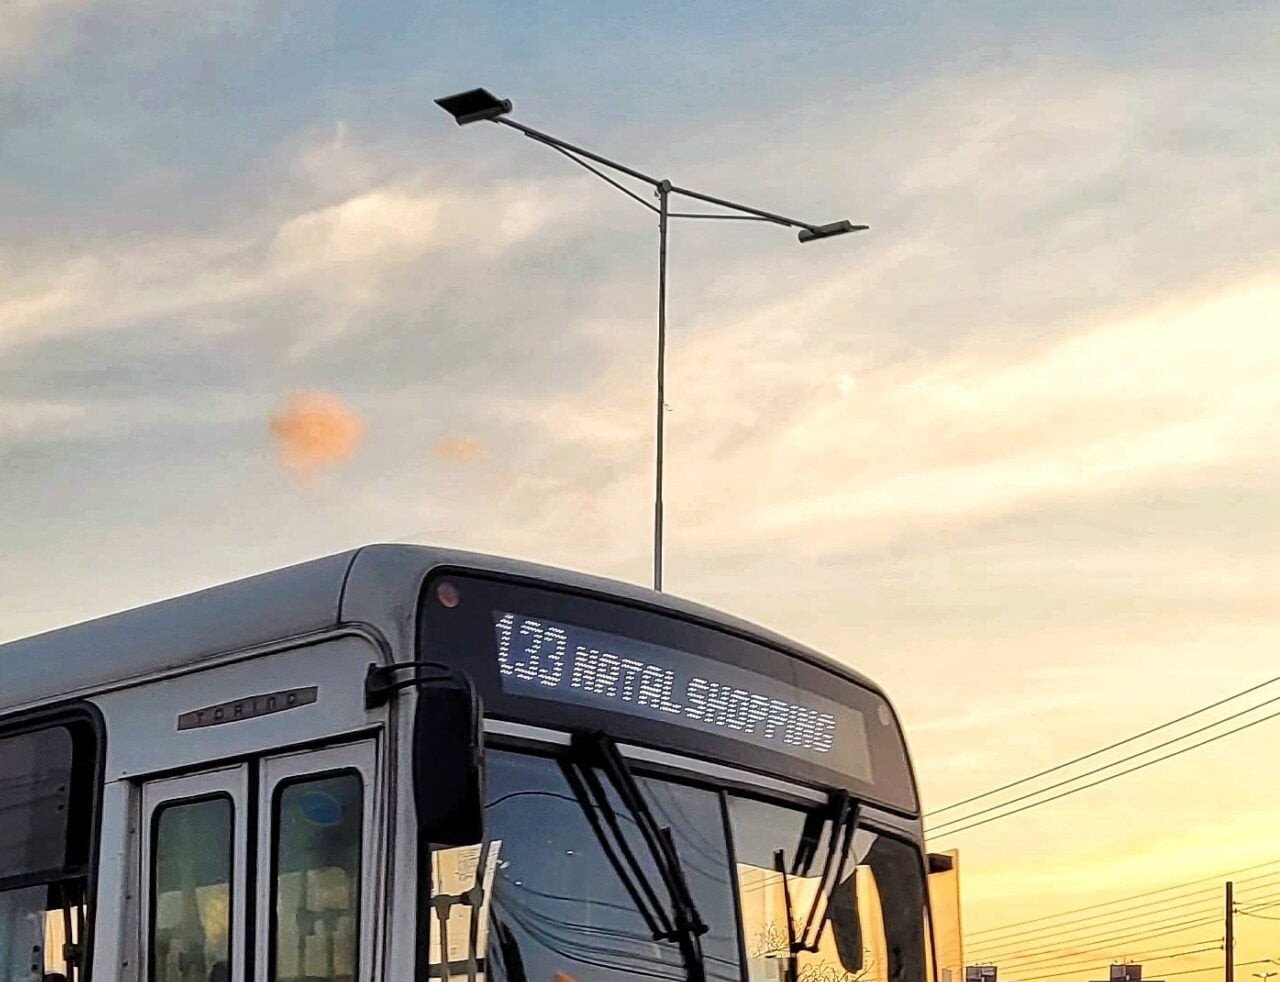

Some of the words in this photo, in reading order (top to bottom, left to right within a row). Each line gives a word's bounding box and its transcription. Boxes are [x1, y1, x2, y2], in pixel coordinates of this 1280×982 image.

[196, 693, 297, 722] TORINO
[496, 614, 567, 687] 133
[571, 646, 683, 714] NATAL
[684, 677, 836, 753] SHOPPING
